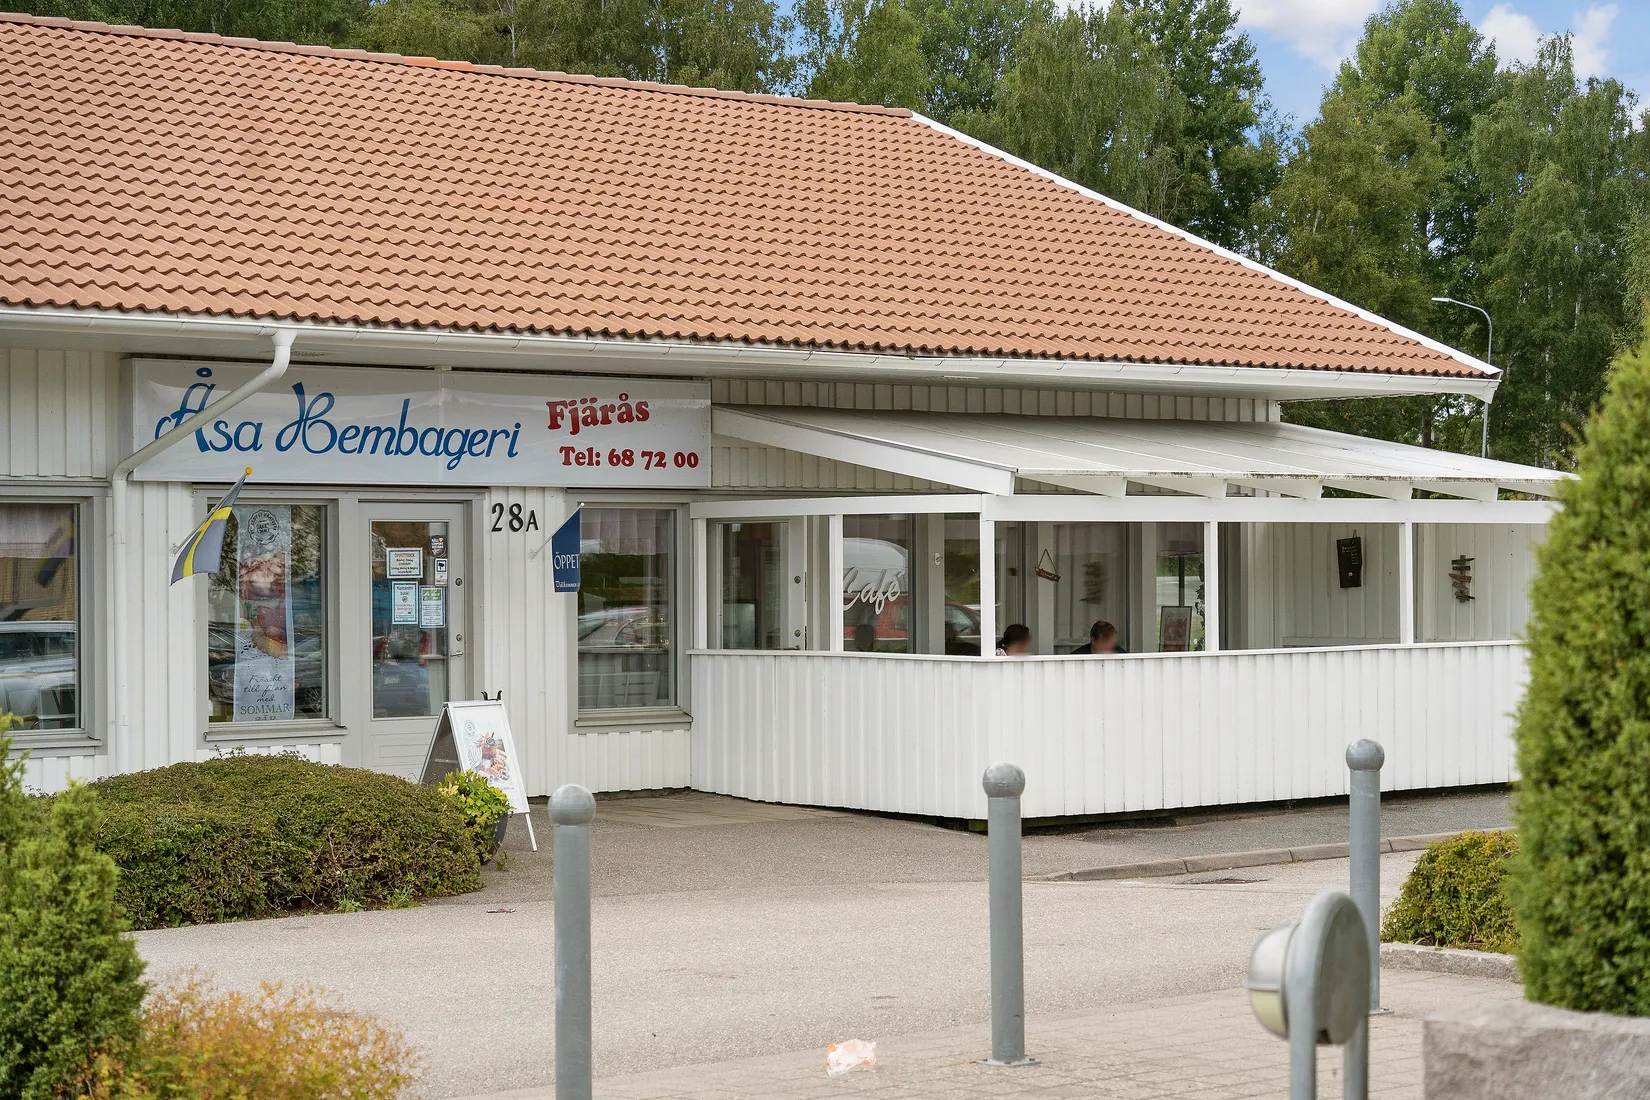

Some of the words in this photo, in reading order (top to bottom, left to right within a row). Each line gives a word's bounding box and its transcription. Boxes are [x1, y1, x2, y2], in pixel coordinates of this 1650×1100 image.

[154, 367, 263, 453] Åsa
[275, 382, 522, 471] Hembageri
[546, 393, 650, 436] Fjärås
[559, 446, 601, 467] Tel:
[608, 448, 635, 467] 68
[641, 450, 667, 471] 72
[673, 452, 699, 468] 00
[490, 502, 539, 533] 28A
[553, 551, 580, 570] ÖPPET
[843, 566, 906, 616] Café
[240, 703, 290, 715] SOMMAR
